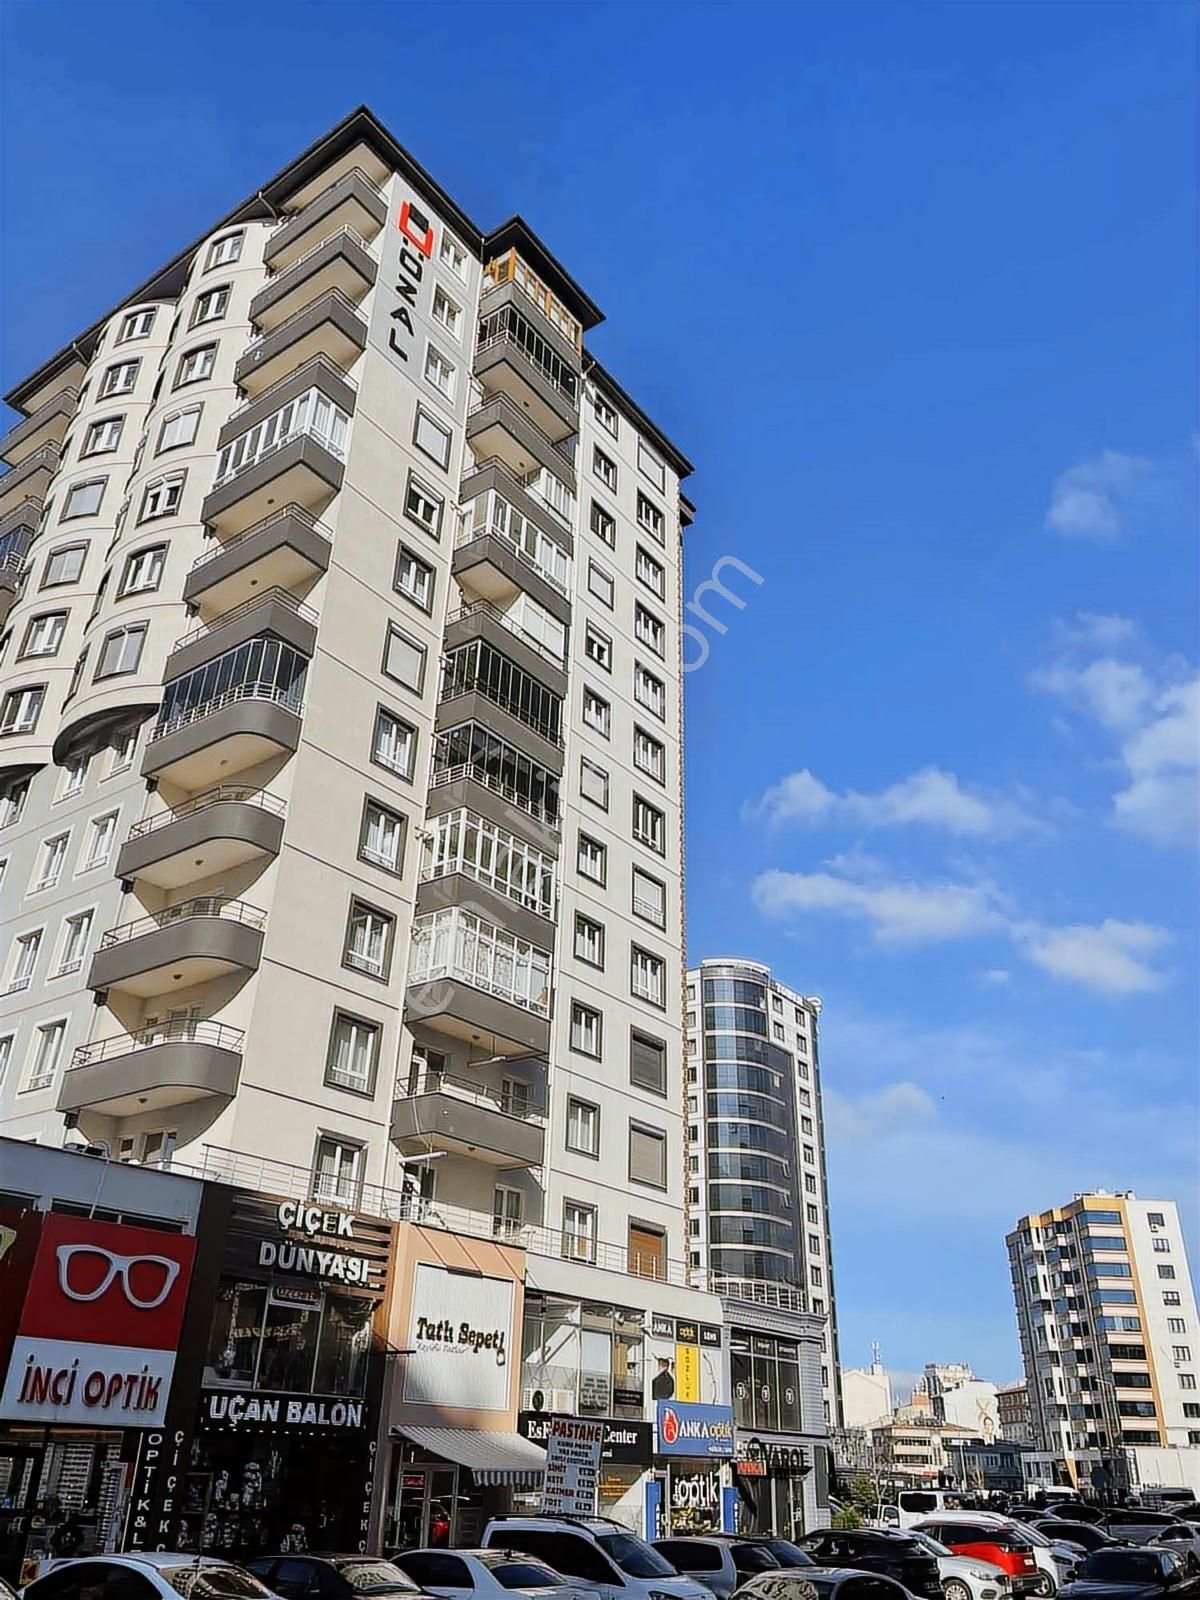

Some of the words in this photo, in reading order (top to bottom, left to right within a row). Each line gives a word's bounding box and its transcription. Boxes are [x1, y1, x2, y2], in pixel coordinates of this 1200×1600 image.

[278, 1201, 357, 1237] ÇİÇEK
[17, 1354, 80, 1406] İNCİ
[82, 1364, 164, 1412] OPTİK
[209, 1395, 280, 1427] UÇAN
[286, 1400, 362, 1428] BALON
[552, 1420, 602, 1442] PASTANE
[679, 1420, 710, 1438] ANKA
